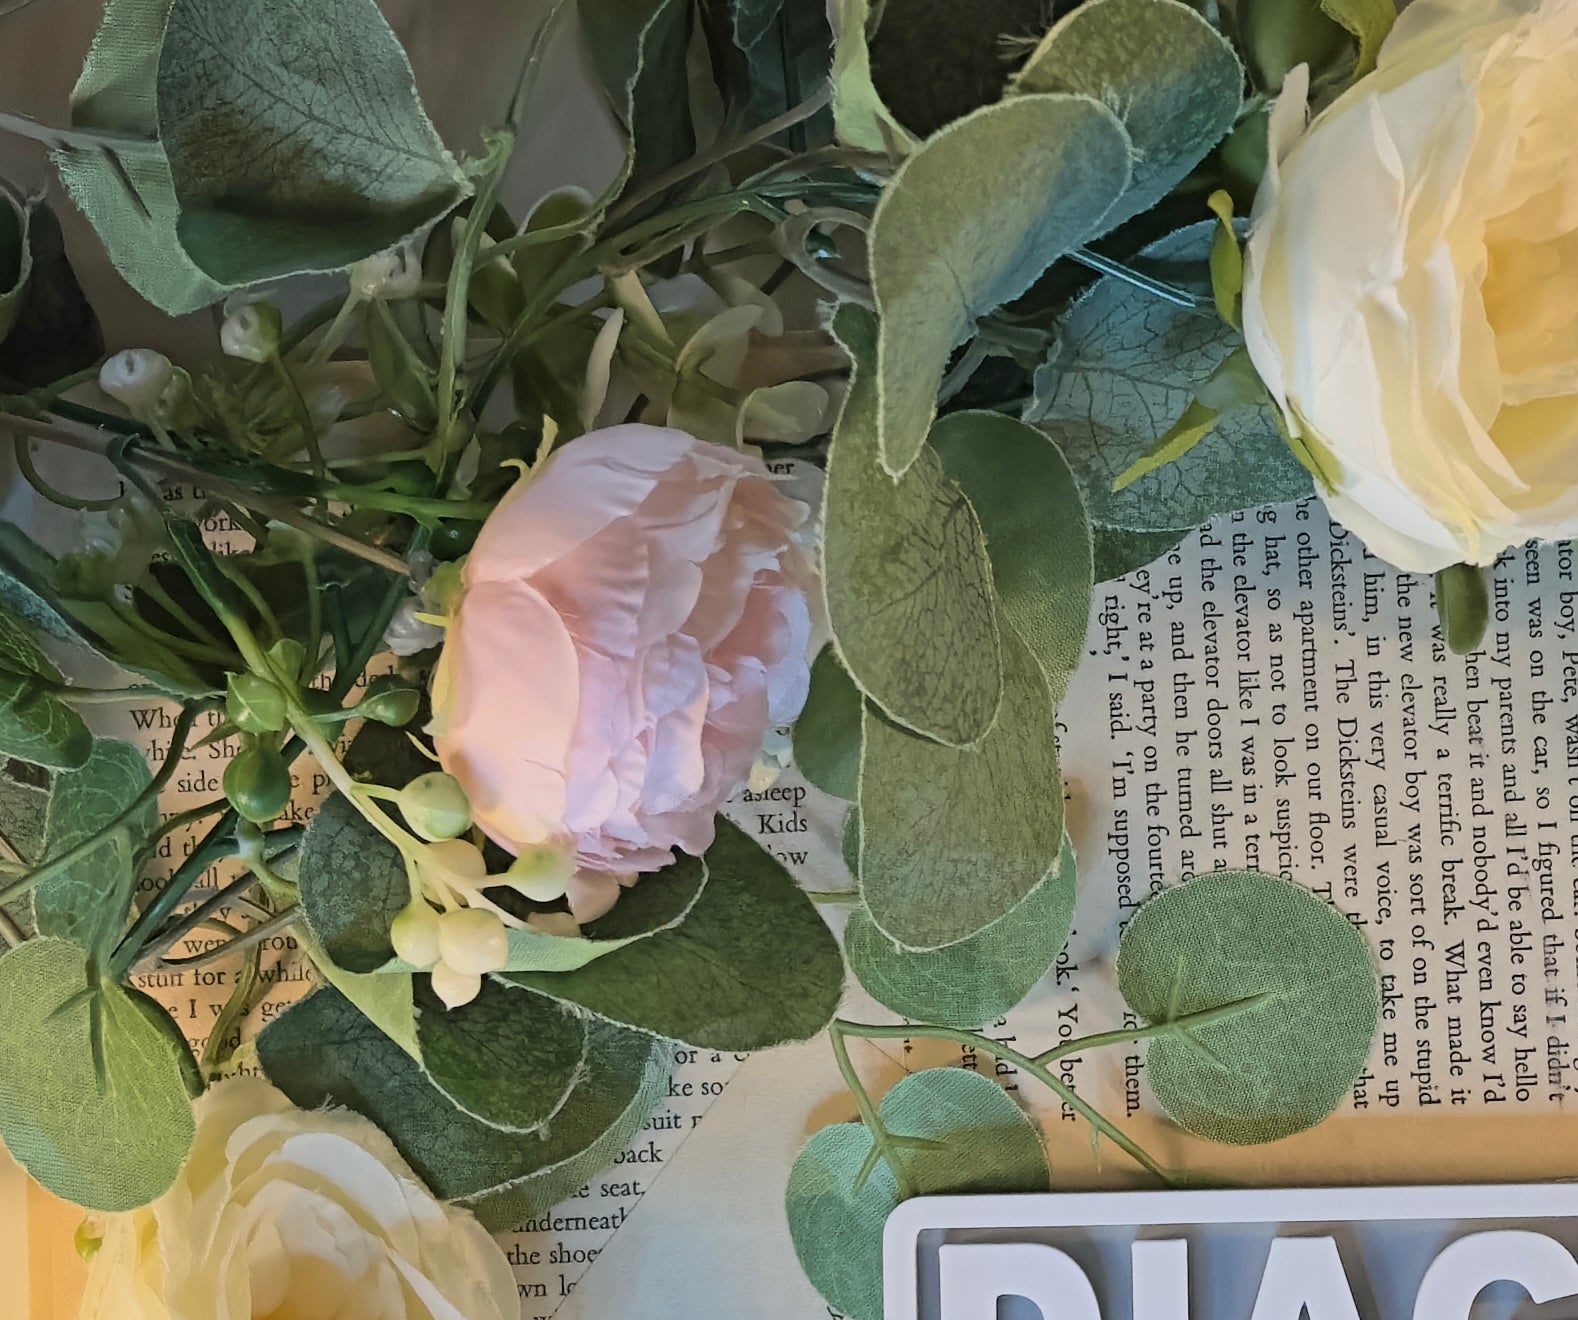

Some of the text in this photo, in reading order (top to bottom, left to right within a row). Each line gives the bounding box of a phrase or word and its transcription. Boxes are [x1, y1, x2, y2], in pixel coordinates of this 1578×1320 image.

[177, 767, 219, 793] side
[1292, 531, 1330, 869] other apartment on our floor.
[757, 811, 808, 835] Kids
[1427, 624, 1471, 1105] was really a terrific break. What made it
